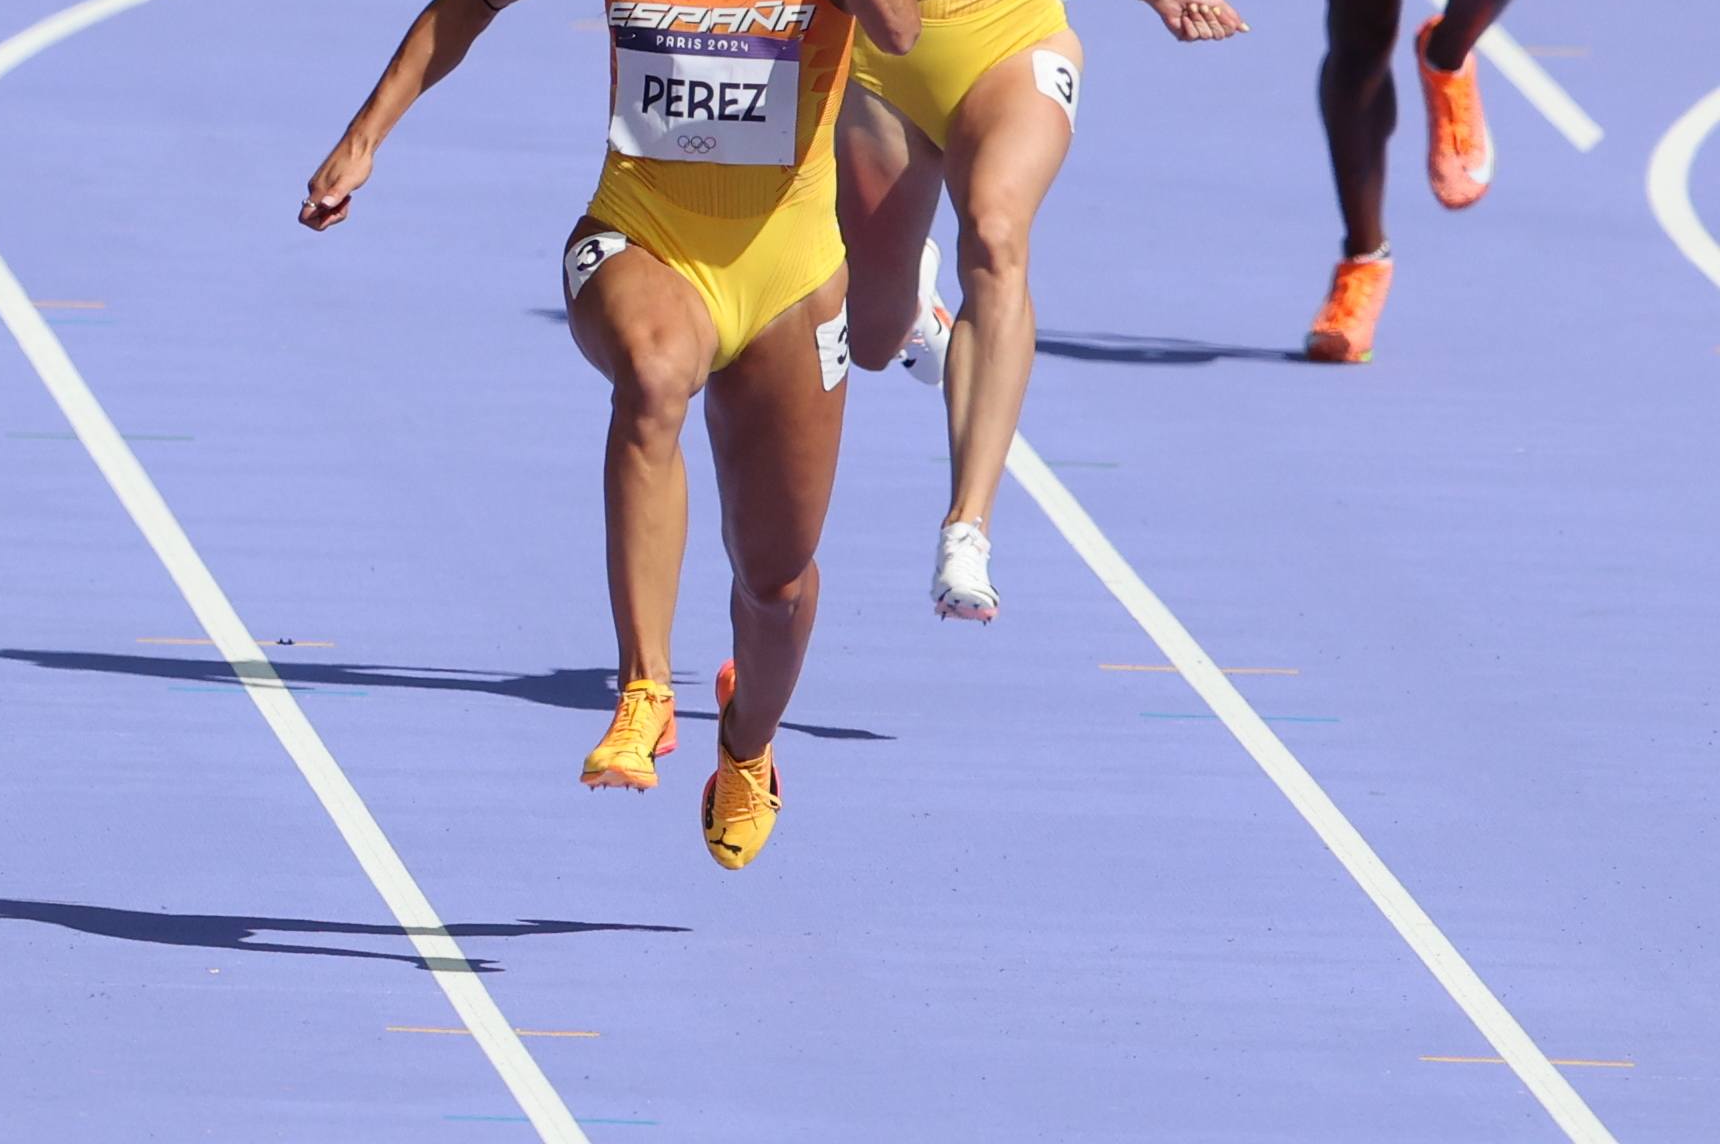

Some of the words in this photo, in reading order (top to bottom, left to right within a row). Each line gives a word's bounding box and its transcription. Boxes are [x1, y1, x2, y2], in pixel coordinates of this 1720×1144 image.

[608, 0, 817, 33] ESPAÑA
[707, 38, 749, 53] 2024
[641, 74, 768, 122] PEREZ
[576, 239, 605, 272] 3
